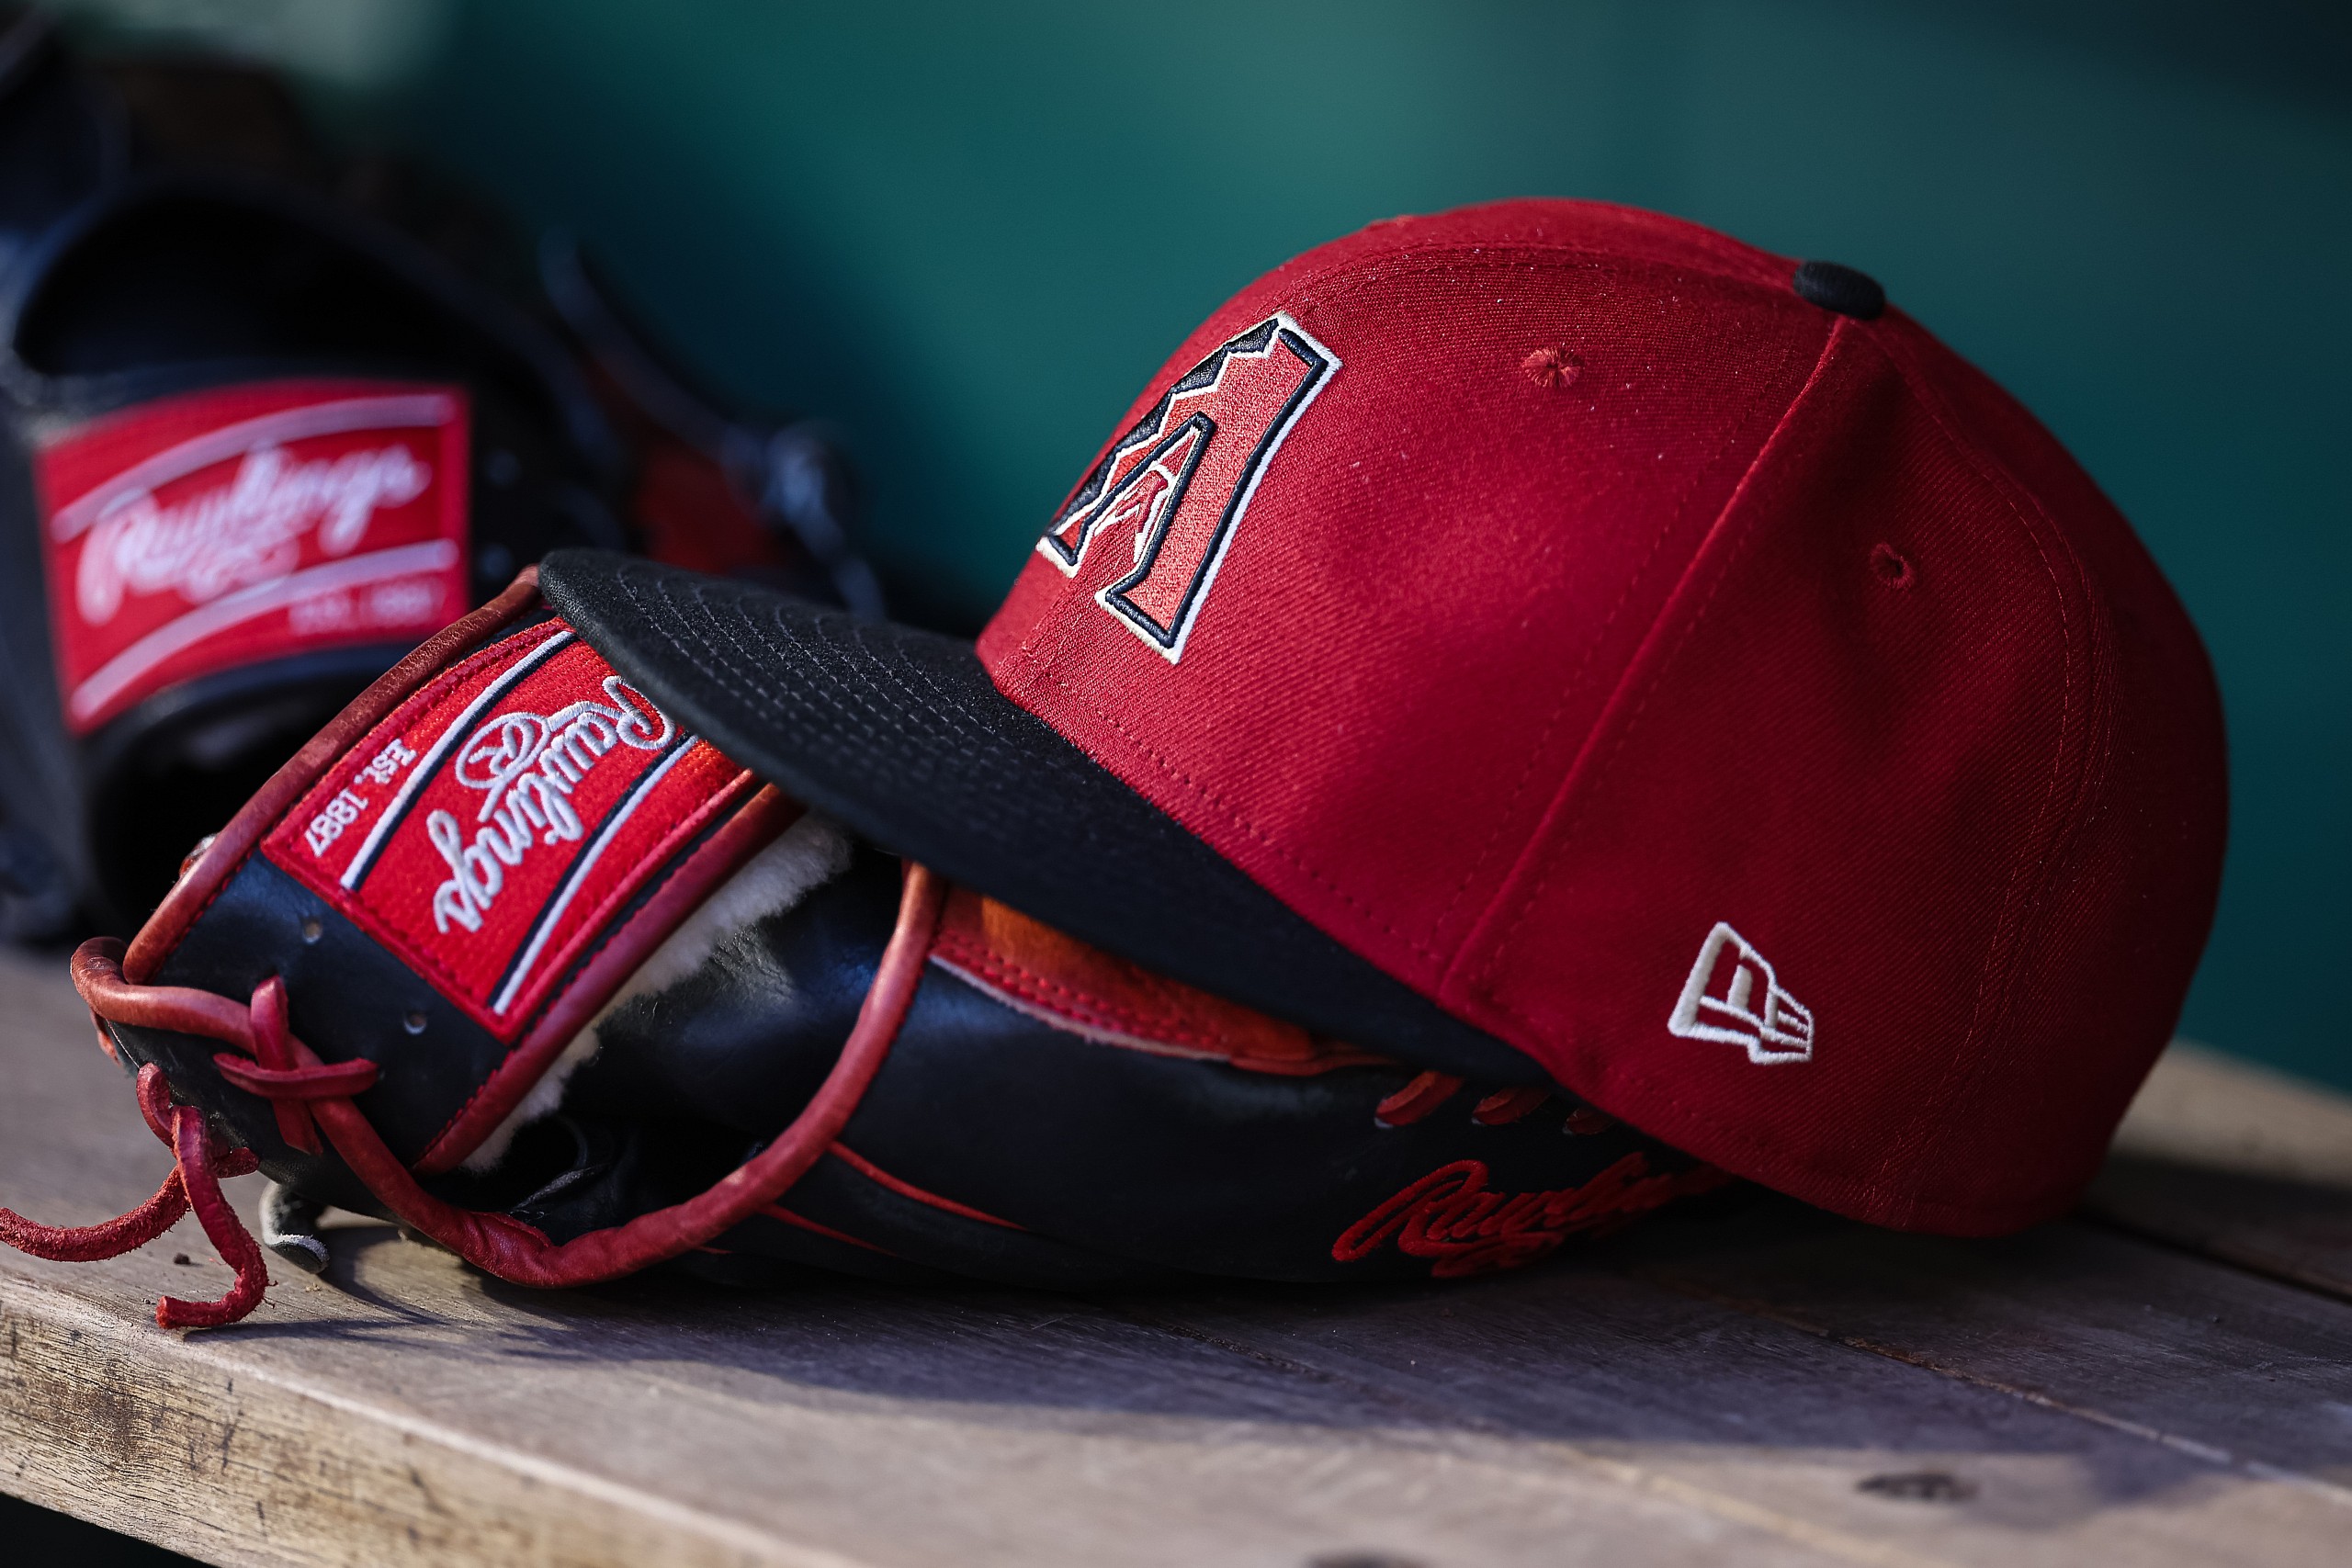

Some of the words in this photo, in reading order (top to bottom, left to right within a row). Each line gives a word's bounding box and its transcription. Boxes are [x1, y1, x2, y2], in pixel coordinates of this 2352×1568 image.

[354, 738, 418, 785] Est.
[304, 787, 368, 858] 1887
[426, 675, 676, 934] Rawlings
